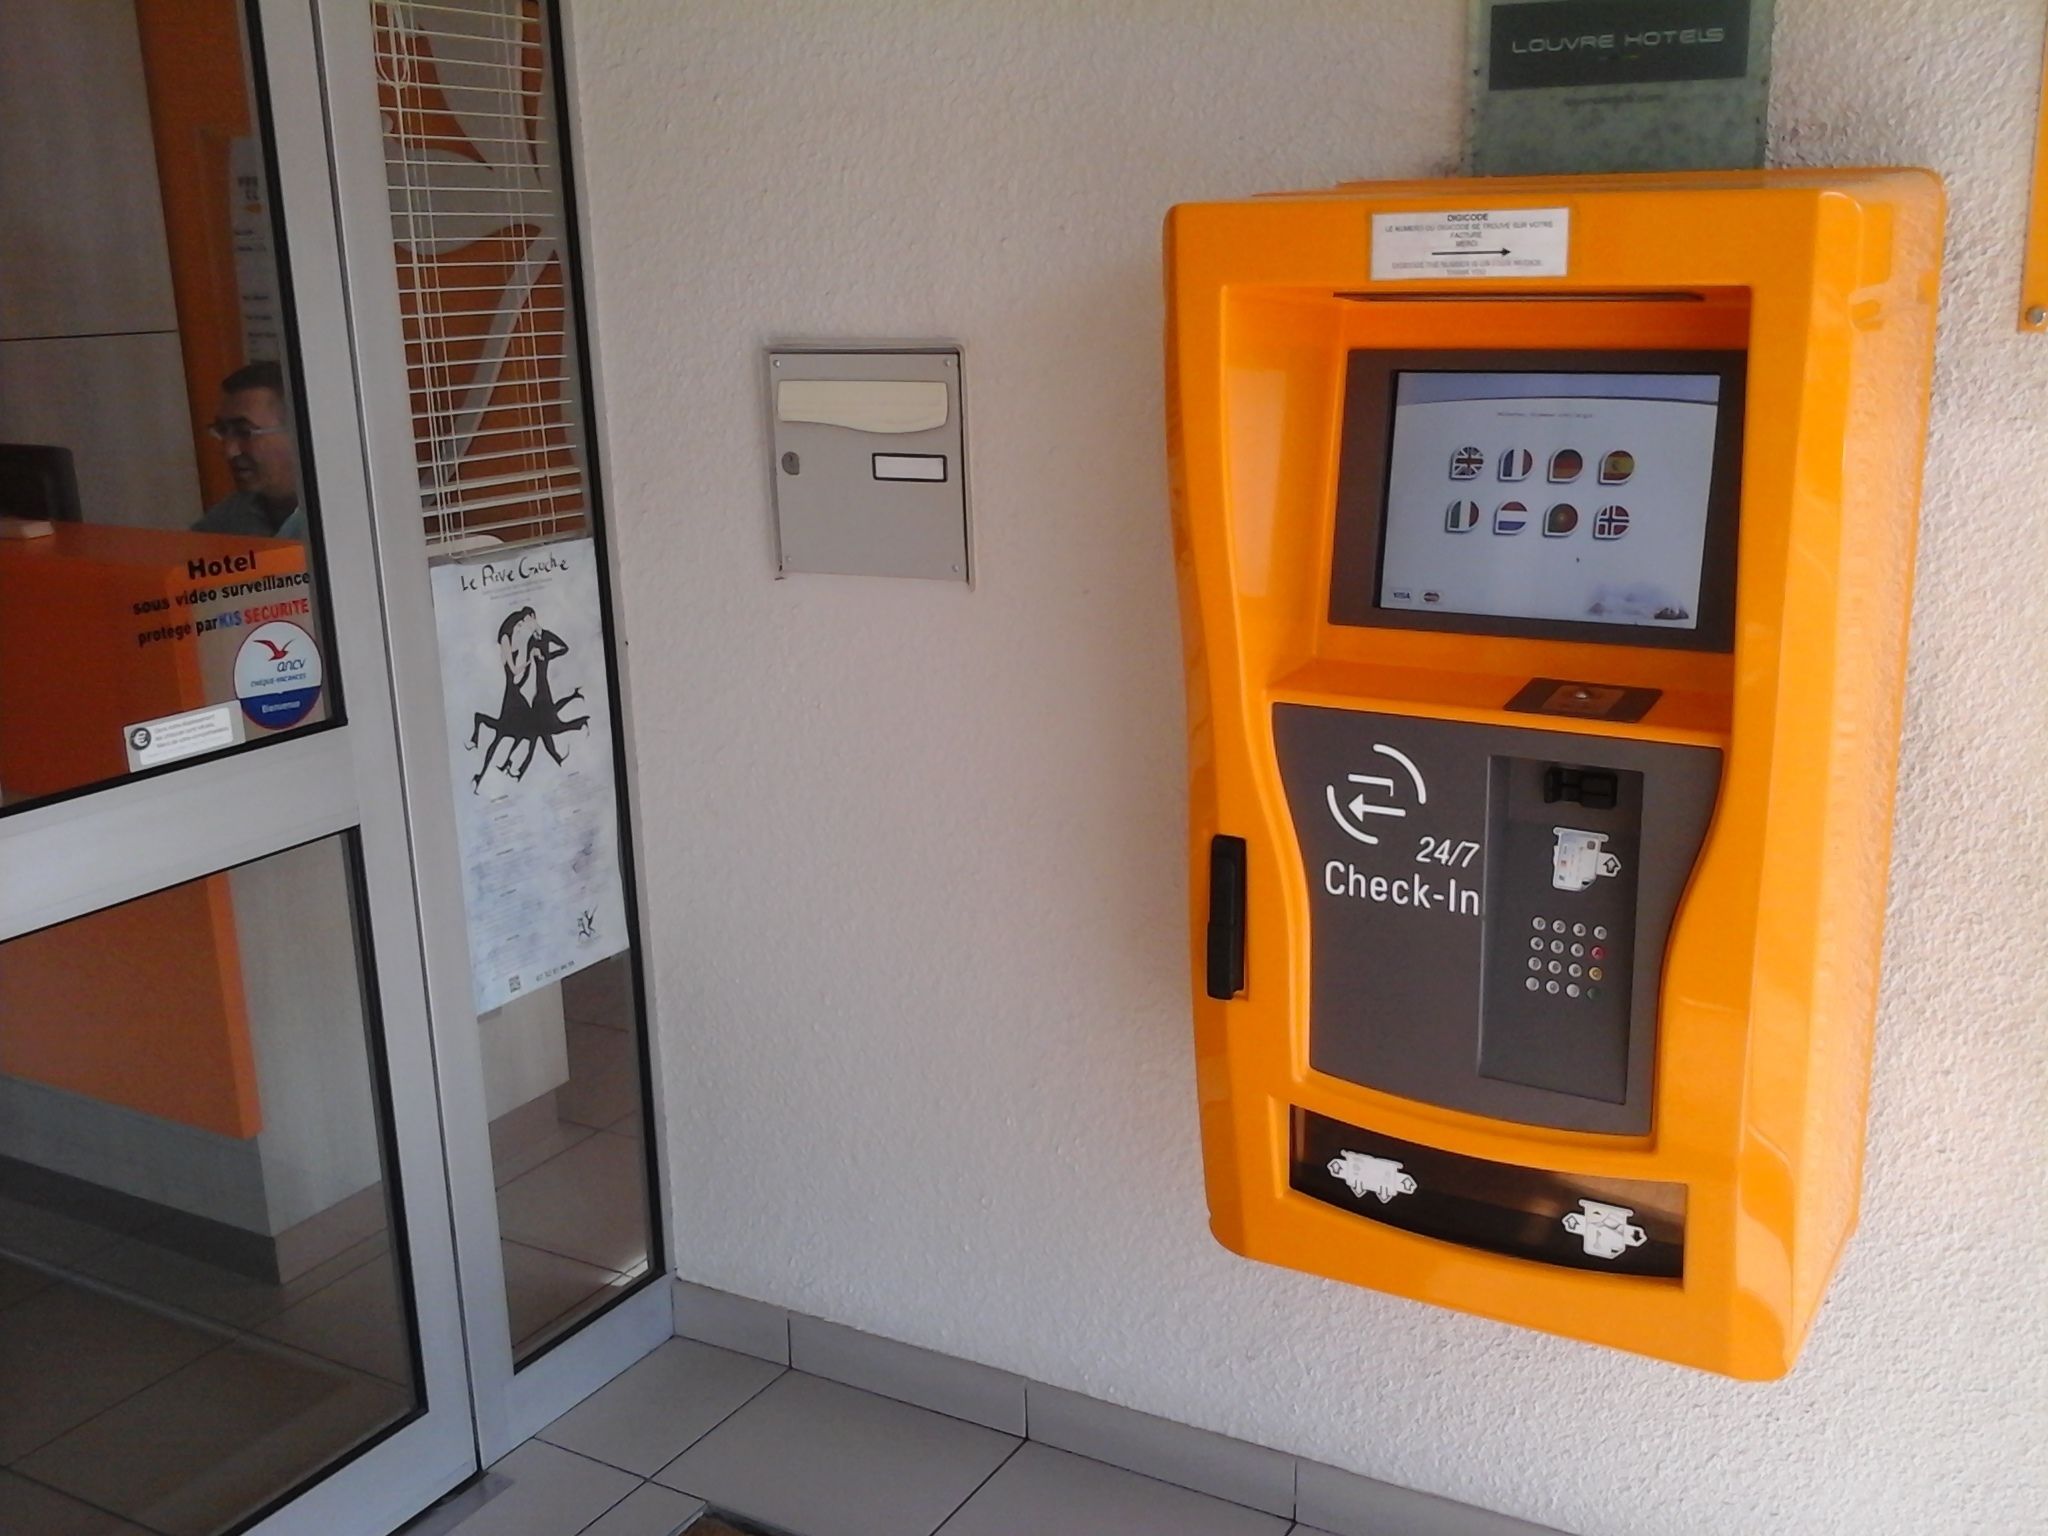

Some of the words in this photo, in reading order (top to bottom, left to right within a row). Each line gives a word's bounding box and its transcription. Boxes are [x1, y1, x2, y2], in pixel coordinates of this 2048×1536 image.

[1511, 34, 1614, 54] LOUVRE
[1624, 27, 1725, 47] HOTELS
[1447, 213, 1488, 222] DIGICODE
[187, 550, 256, 580] Hotel
[133, 598, 170, 616] sous
[222, 572, 310, 599] surveillance
[460, 575, 477, 591] Le
[195, 618, 217, 636] par
[244, 598, 309, 625] SECURITE
[276, 657, 306, 673] ancv
[1414, 835, 1481, 869] 24/7
[1324, 859, 1480, 917] Check-In
